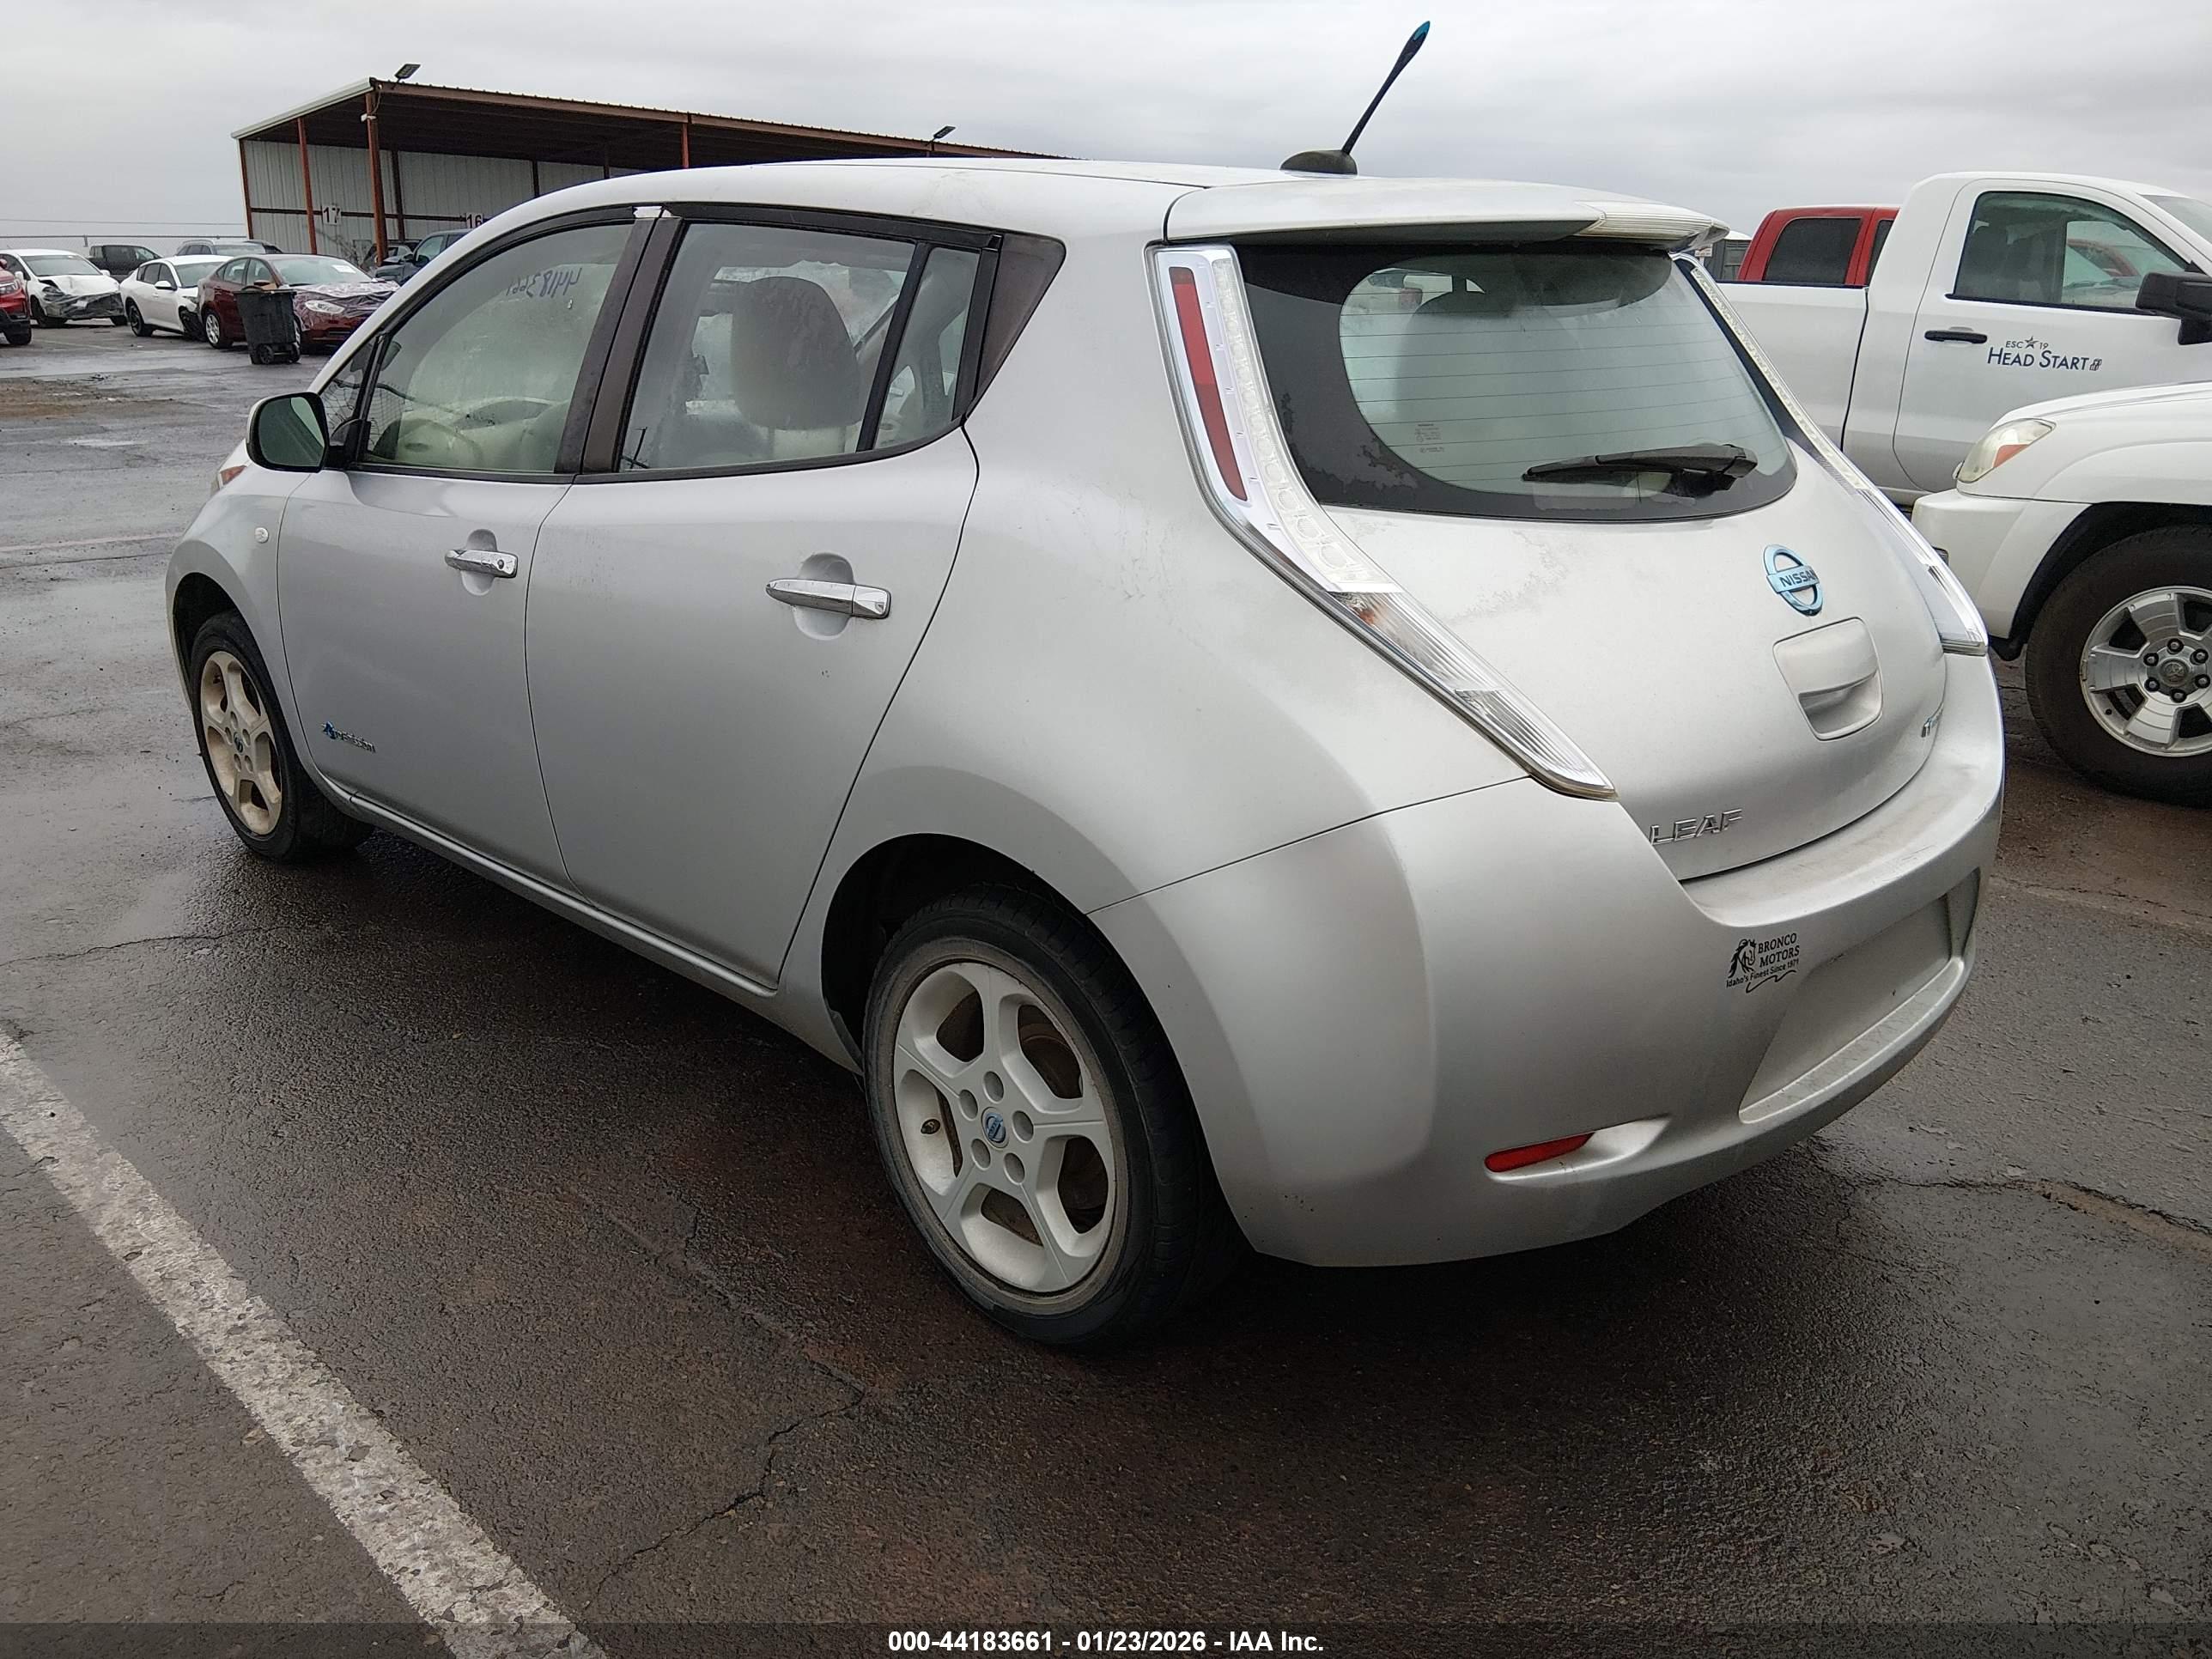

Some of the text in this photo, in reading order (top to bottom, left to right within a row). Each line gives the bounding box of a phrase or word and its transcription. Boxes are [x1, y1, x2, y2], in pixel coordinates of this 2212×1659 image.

[323, 207, 341, 223] 17
[466, 214, 483, 228] 16
[2005, 340, 2049, 350] ESC 19
[1987, 346, 2090, 370] HEAD START
[1779, 568, 1817, 587] NISSAN
[1649, 808, 1743, 846] LEAF
[1758, 933, 1797, 954] BRONCO
[1759, 945, 1800, 968] MOTORS
[1726, 975, 1748, 988] Idaho's
[1750, 968, 1769, 981] Finest
[1770, 963, 1786, 975] Since
